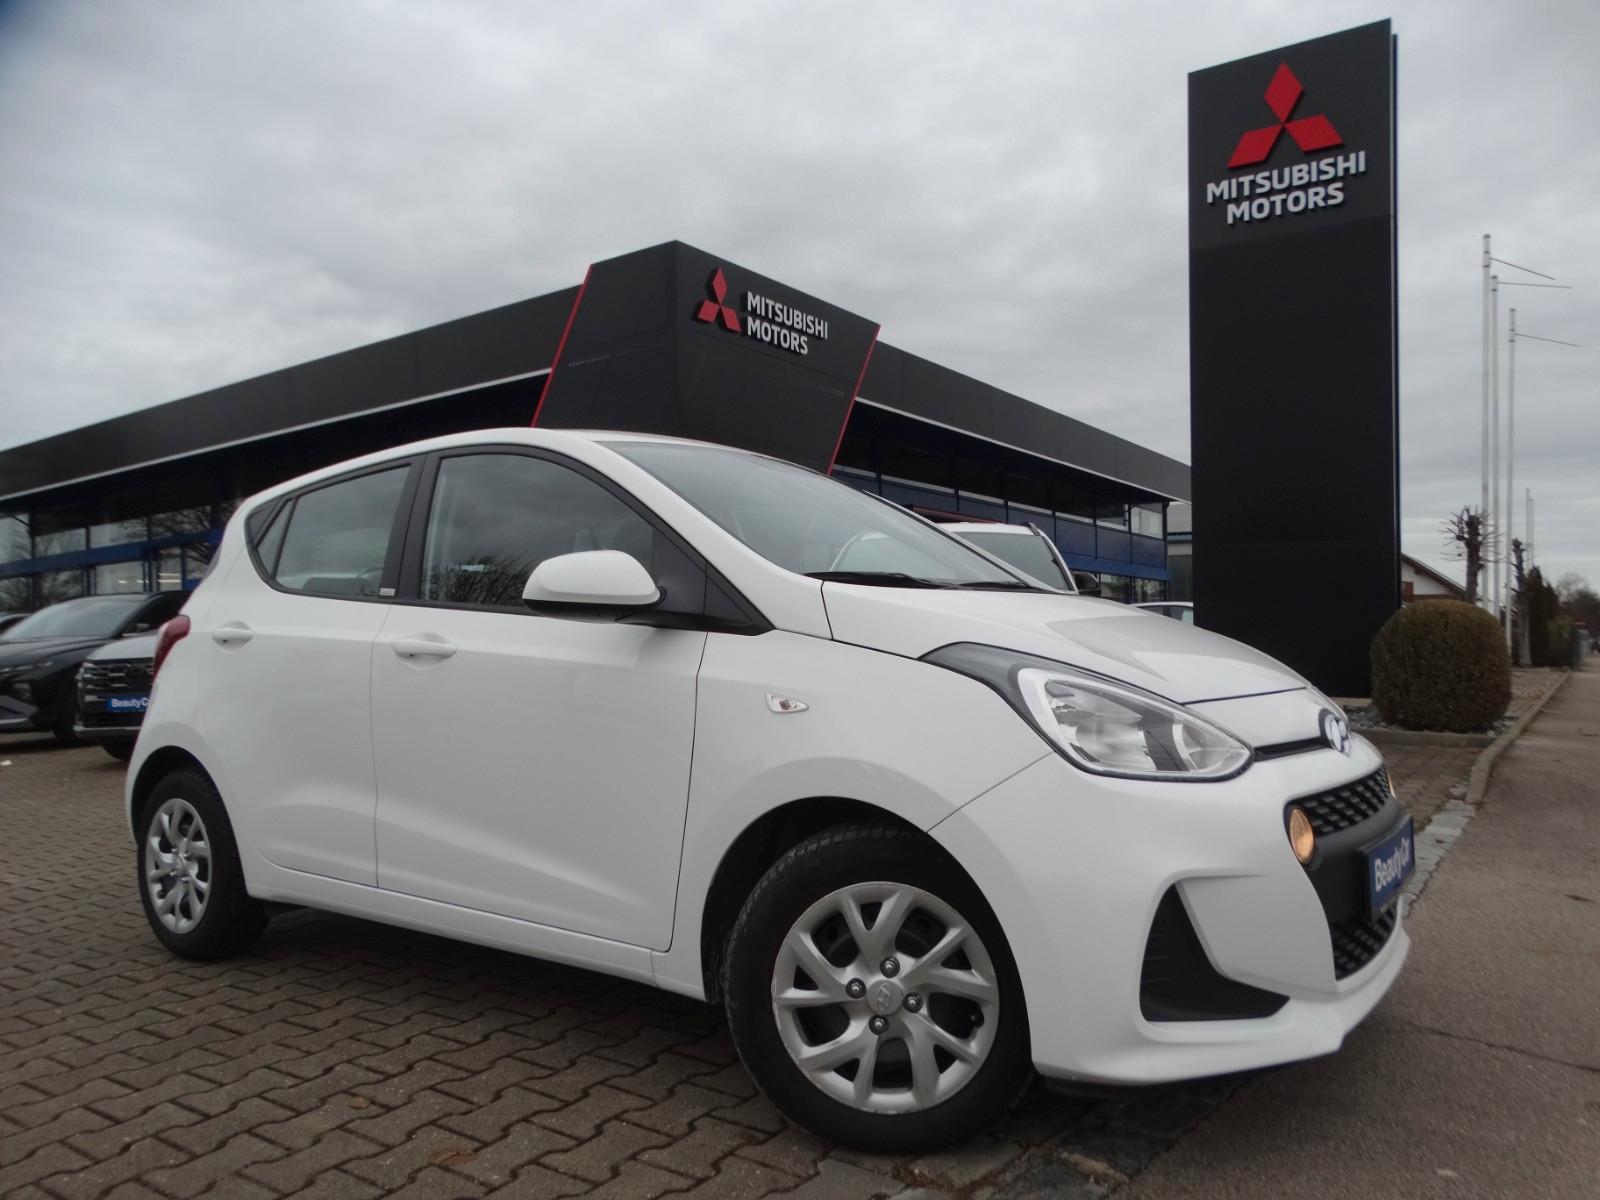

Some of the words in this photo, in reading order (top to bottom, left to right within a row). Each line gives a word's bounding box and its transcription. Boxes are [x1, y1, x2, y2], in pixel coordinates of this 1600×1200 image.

[1206, 151, 1366, 203] MITSUBISHI
[1227, 182, 1344, 224] MOTORS
[747, 291, 828, 340] MITSUBISHI
[747, 316, 808, 355] MOTORS
[112, 697, 150, 708] BeautyC
